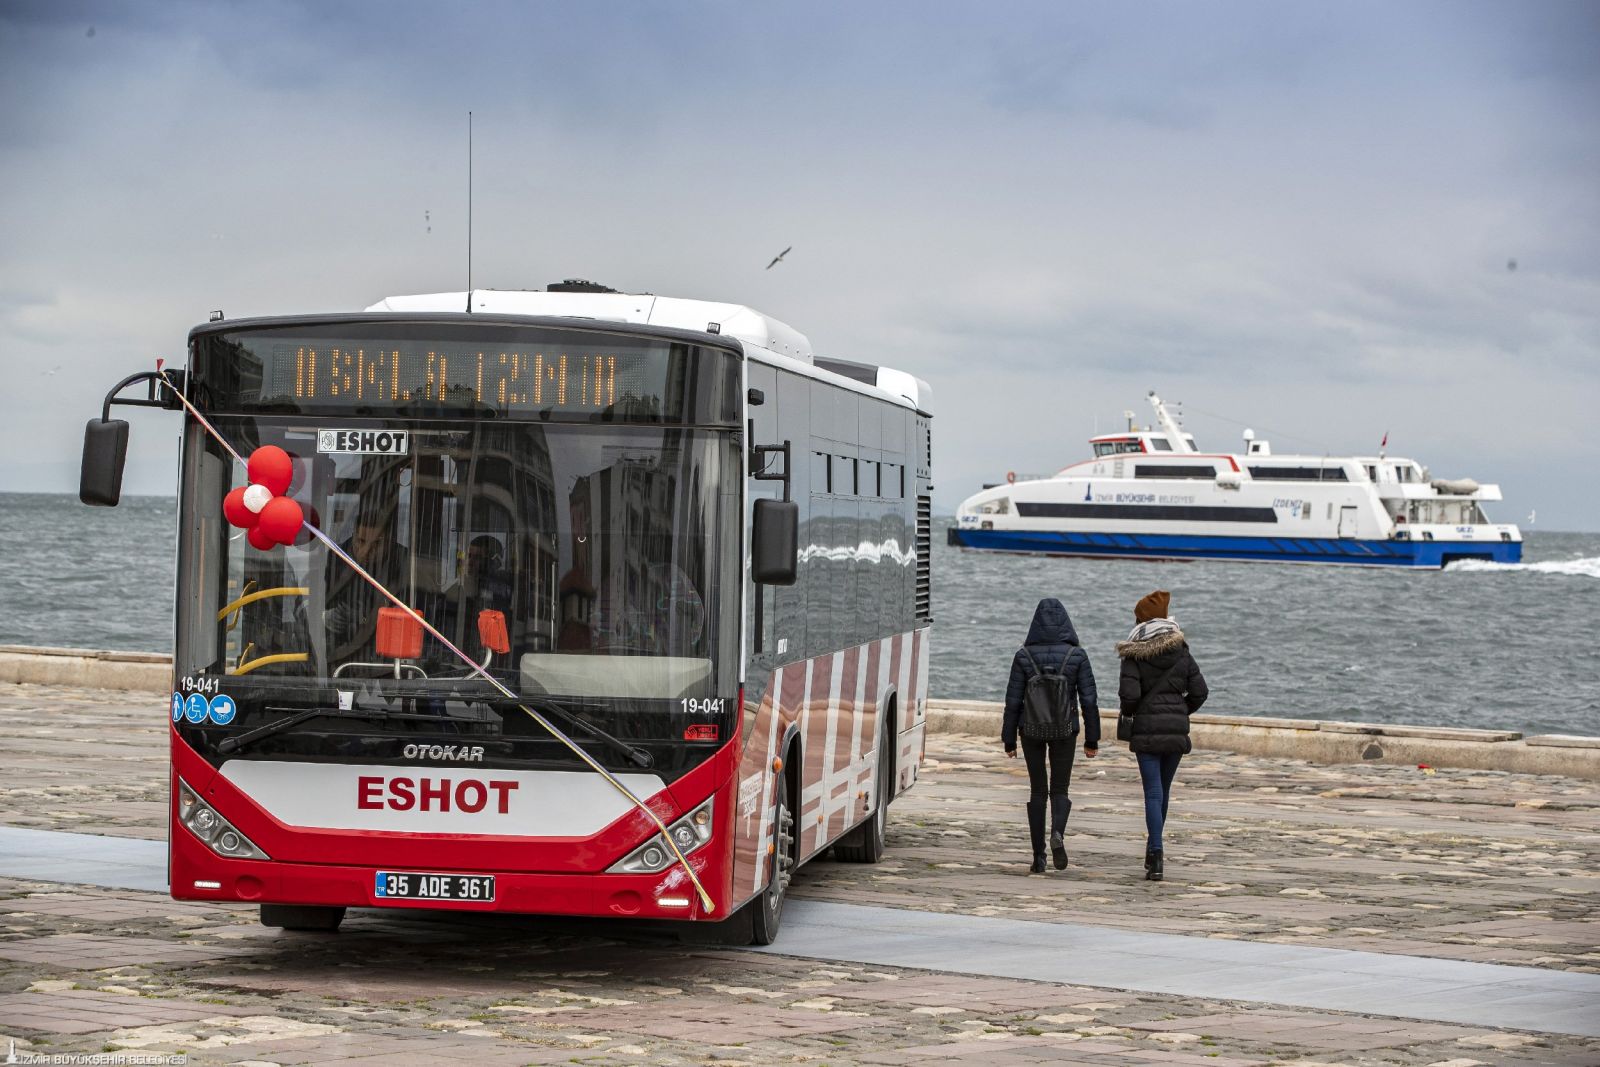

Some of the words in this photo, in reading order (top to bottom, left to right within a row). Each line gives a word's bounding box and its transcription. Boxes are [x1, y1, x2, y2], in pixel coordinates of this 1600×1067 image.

[336, 432, 404, 451] ESHOT
[181, 676, 219, 693] 19-041
[681, 698, 724, 713] 19-041
[403, 744, 485, 761] OTOKAR
[357, 776, 519, 814] ESHOT
[386, 875, 409, 895] 35
[418, 876, 451, 897] ADE
[458, 878, 490, 898] 361
